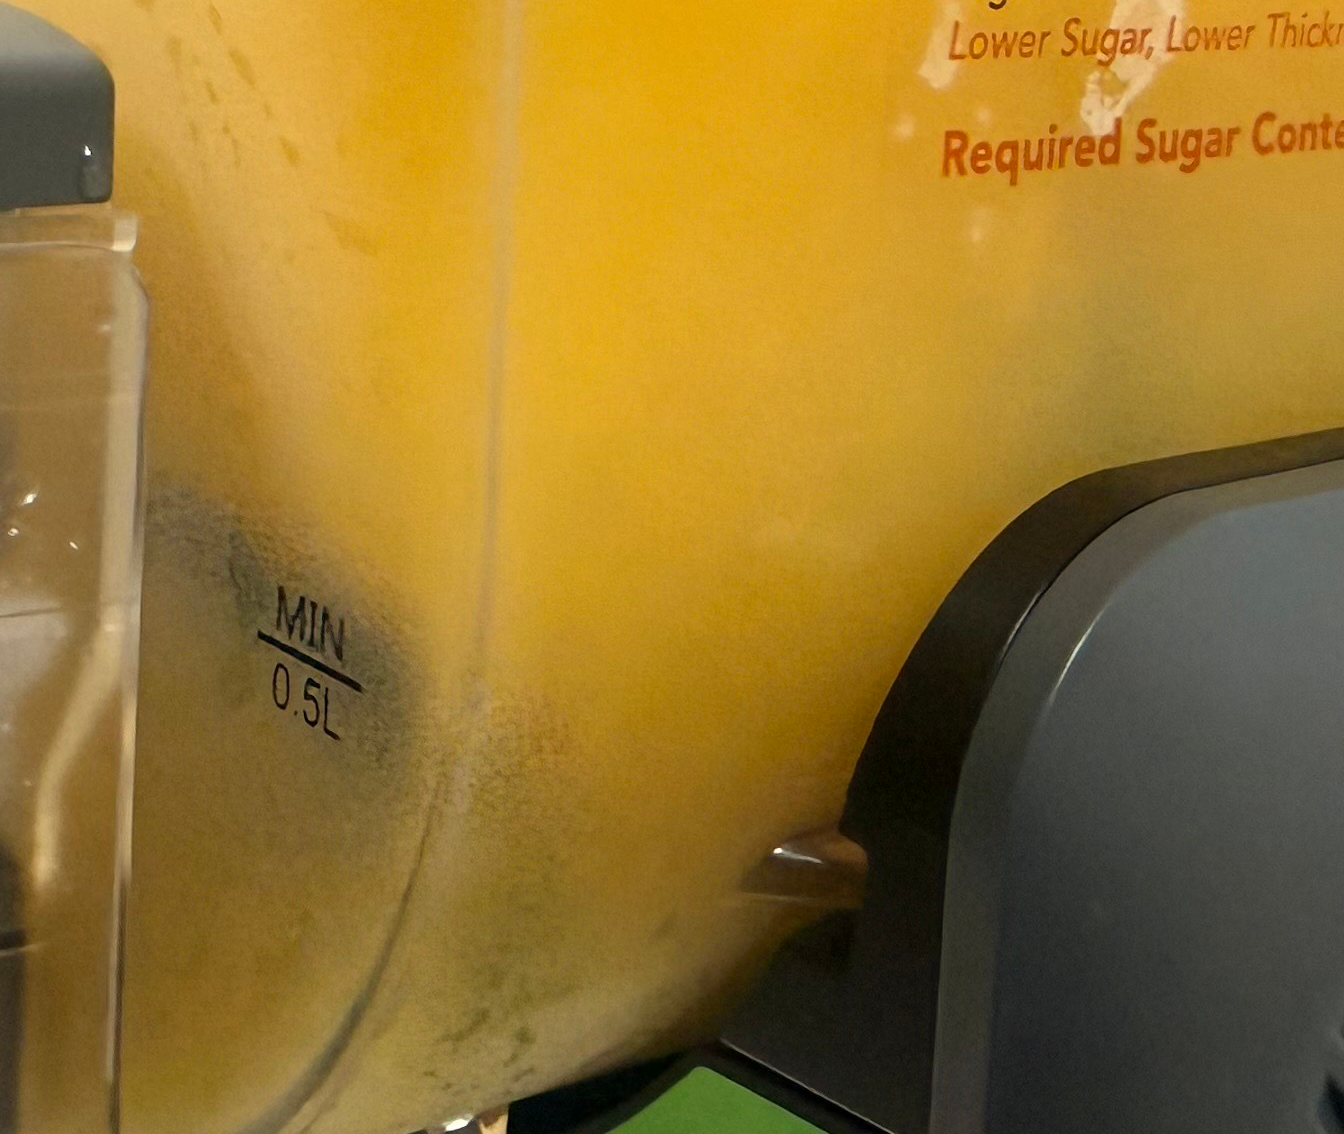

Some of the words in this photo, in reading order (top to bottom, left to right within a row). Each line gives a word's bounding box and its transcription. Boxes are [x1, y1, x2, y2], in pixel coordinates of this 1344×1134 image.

[948, 20, 1050, 60] Lower
[1061, 17, 1154, 66] Sugar,
[1166, 15, 1256, 53] Lower
[942, 120, 1122, 186] Required
[1135, 119, 1240, 173] Sugar
[276, 585, 345, 662] MIN
[272, 662, 341, 741] 0.5L
